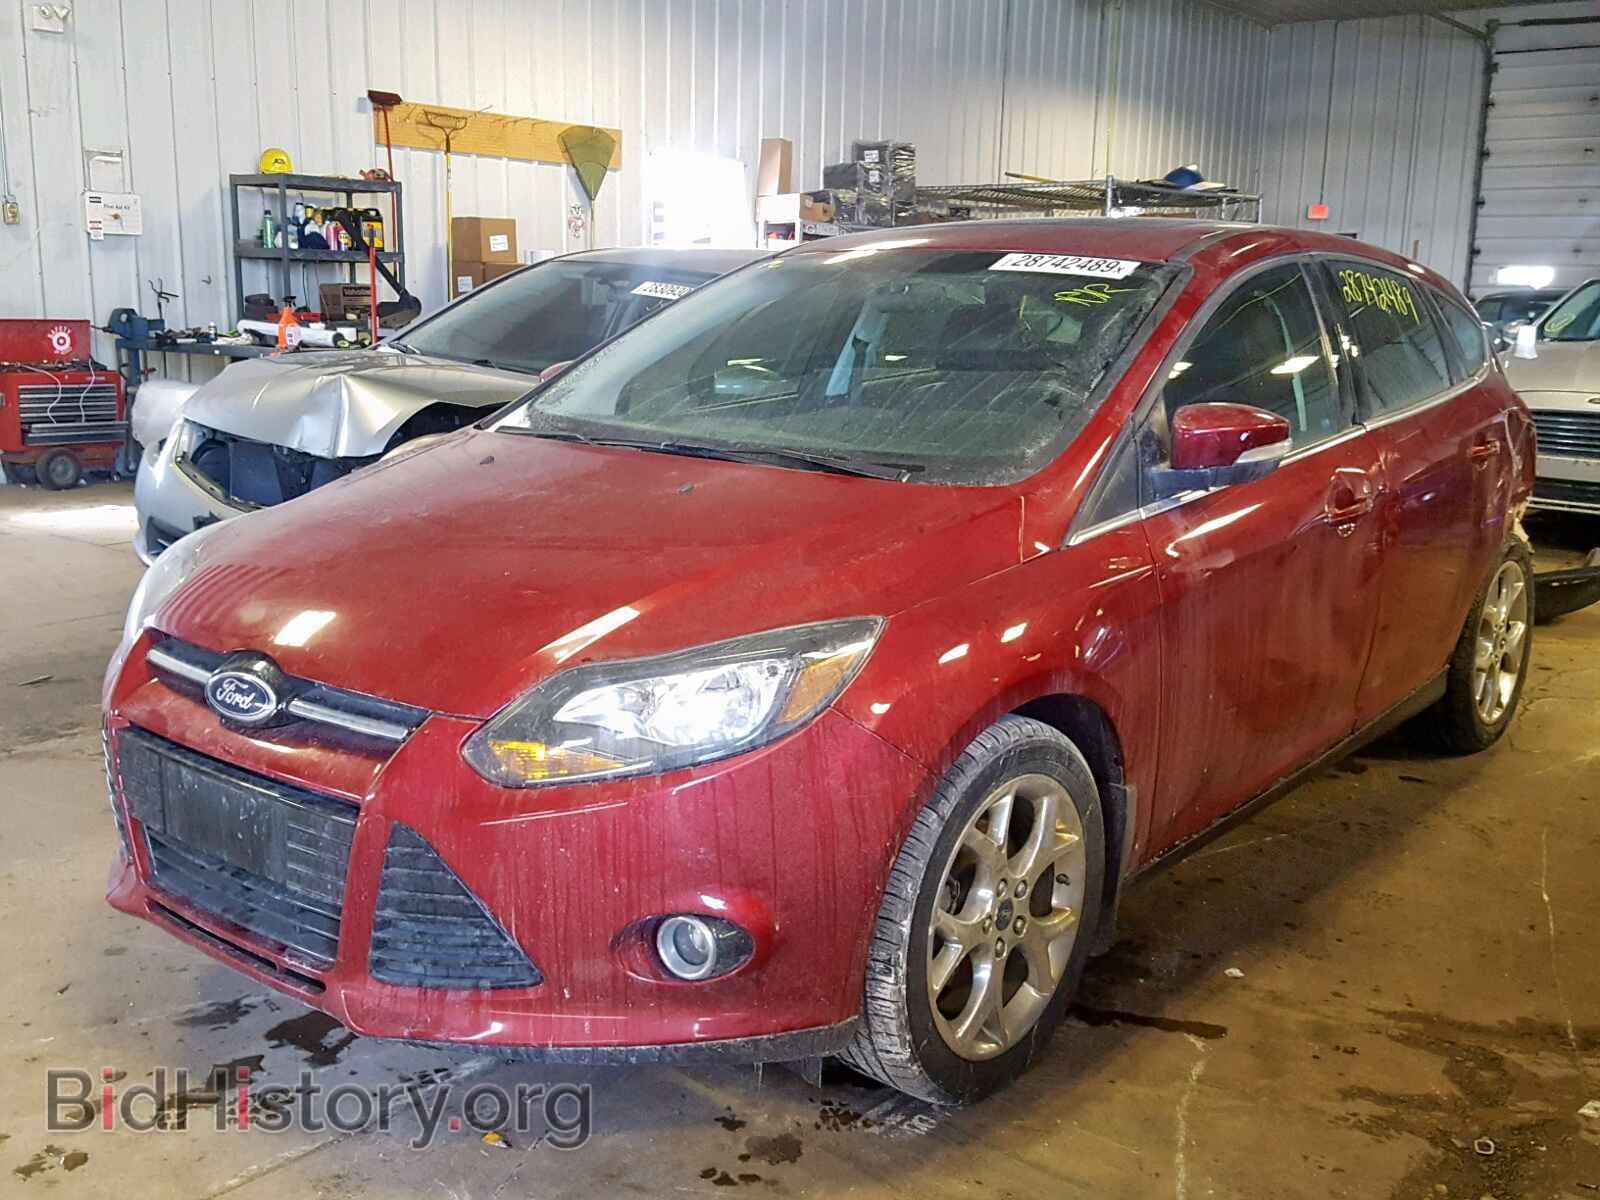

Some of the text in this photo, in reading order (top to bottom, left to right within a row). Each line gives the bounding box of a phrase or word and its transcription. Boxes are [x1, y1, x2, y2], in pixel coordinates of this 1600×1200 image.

[1011, 254, 1118, 273] 28742489
[1339, 269, 1420, 325] 28742489
[216, 678, 261, 710] Ford
